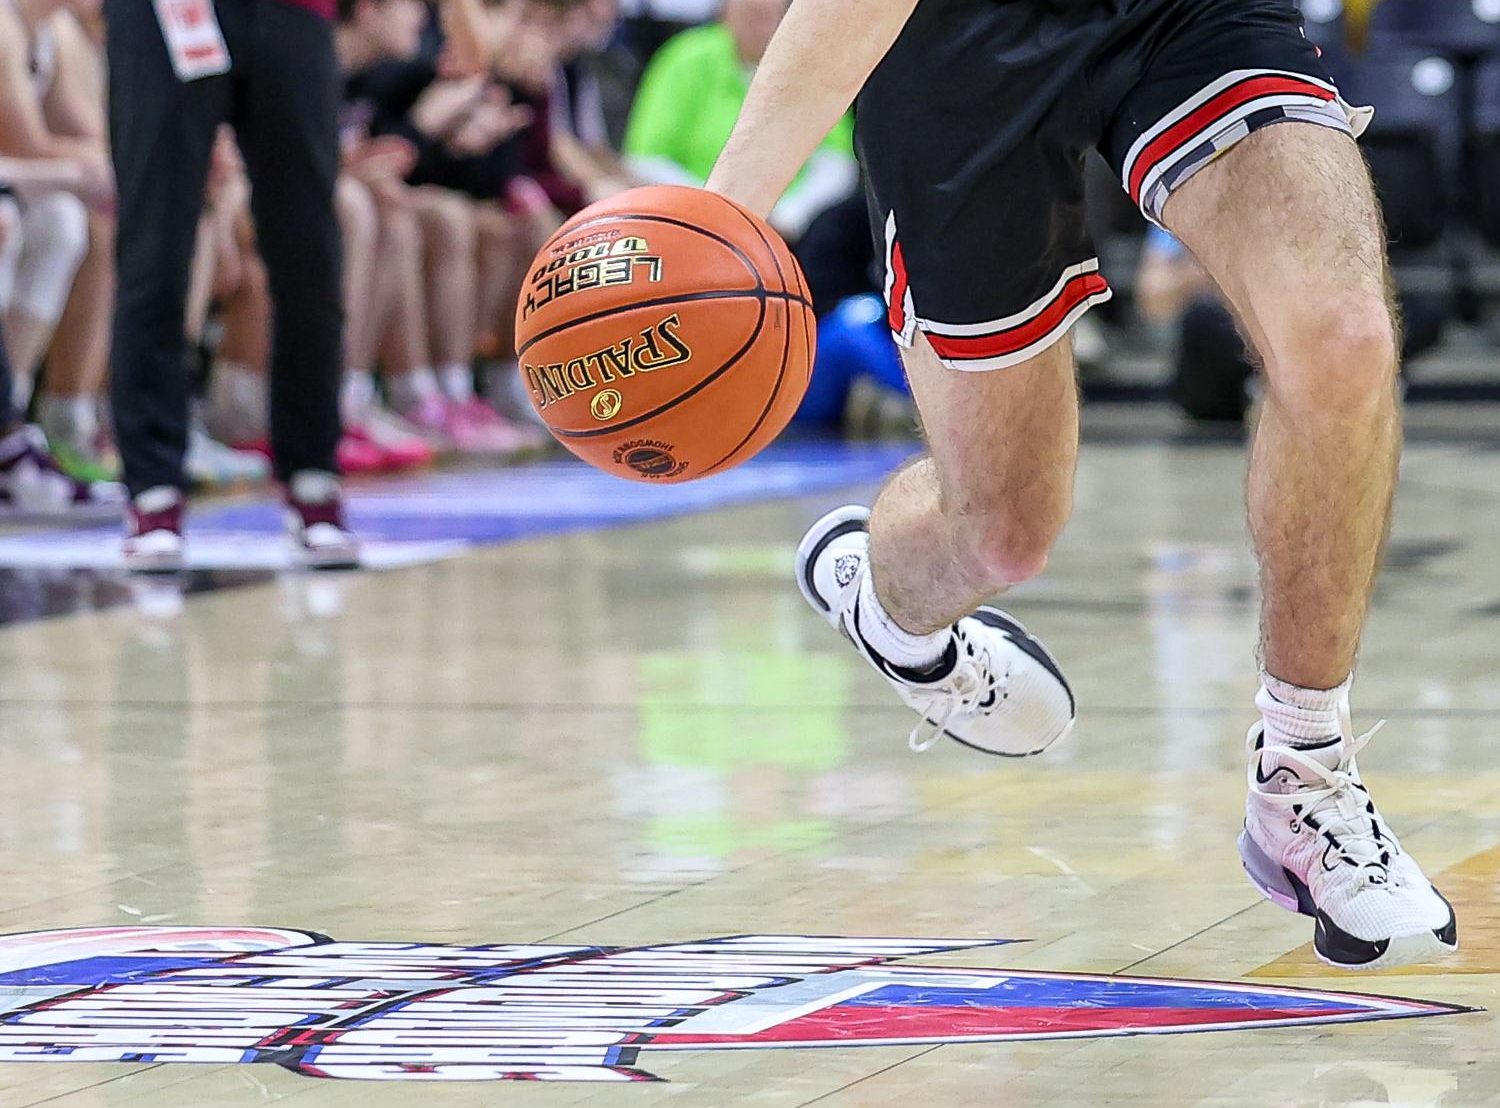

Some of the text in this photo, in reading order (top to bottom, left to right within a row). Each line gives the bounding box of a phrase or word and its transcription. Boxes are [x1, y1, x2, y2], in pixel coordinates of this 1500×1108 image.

[523, 256, 662, 322] LEGACY
[525, 313, 692, 409] SPALDING
[0, 941, 618, 1063] SHOW-ME
[296, 935, 1034, 1081] SHOWDOWN
